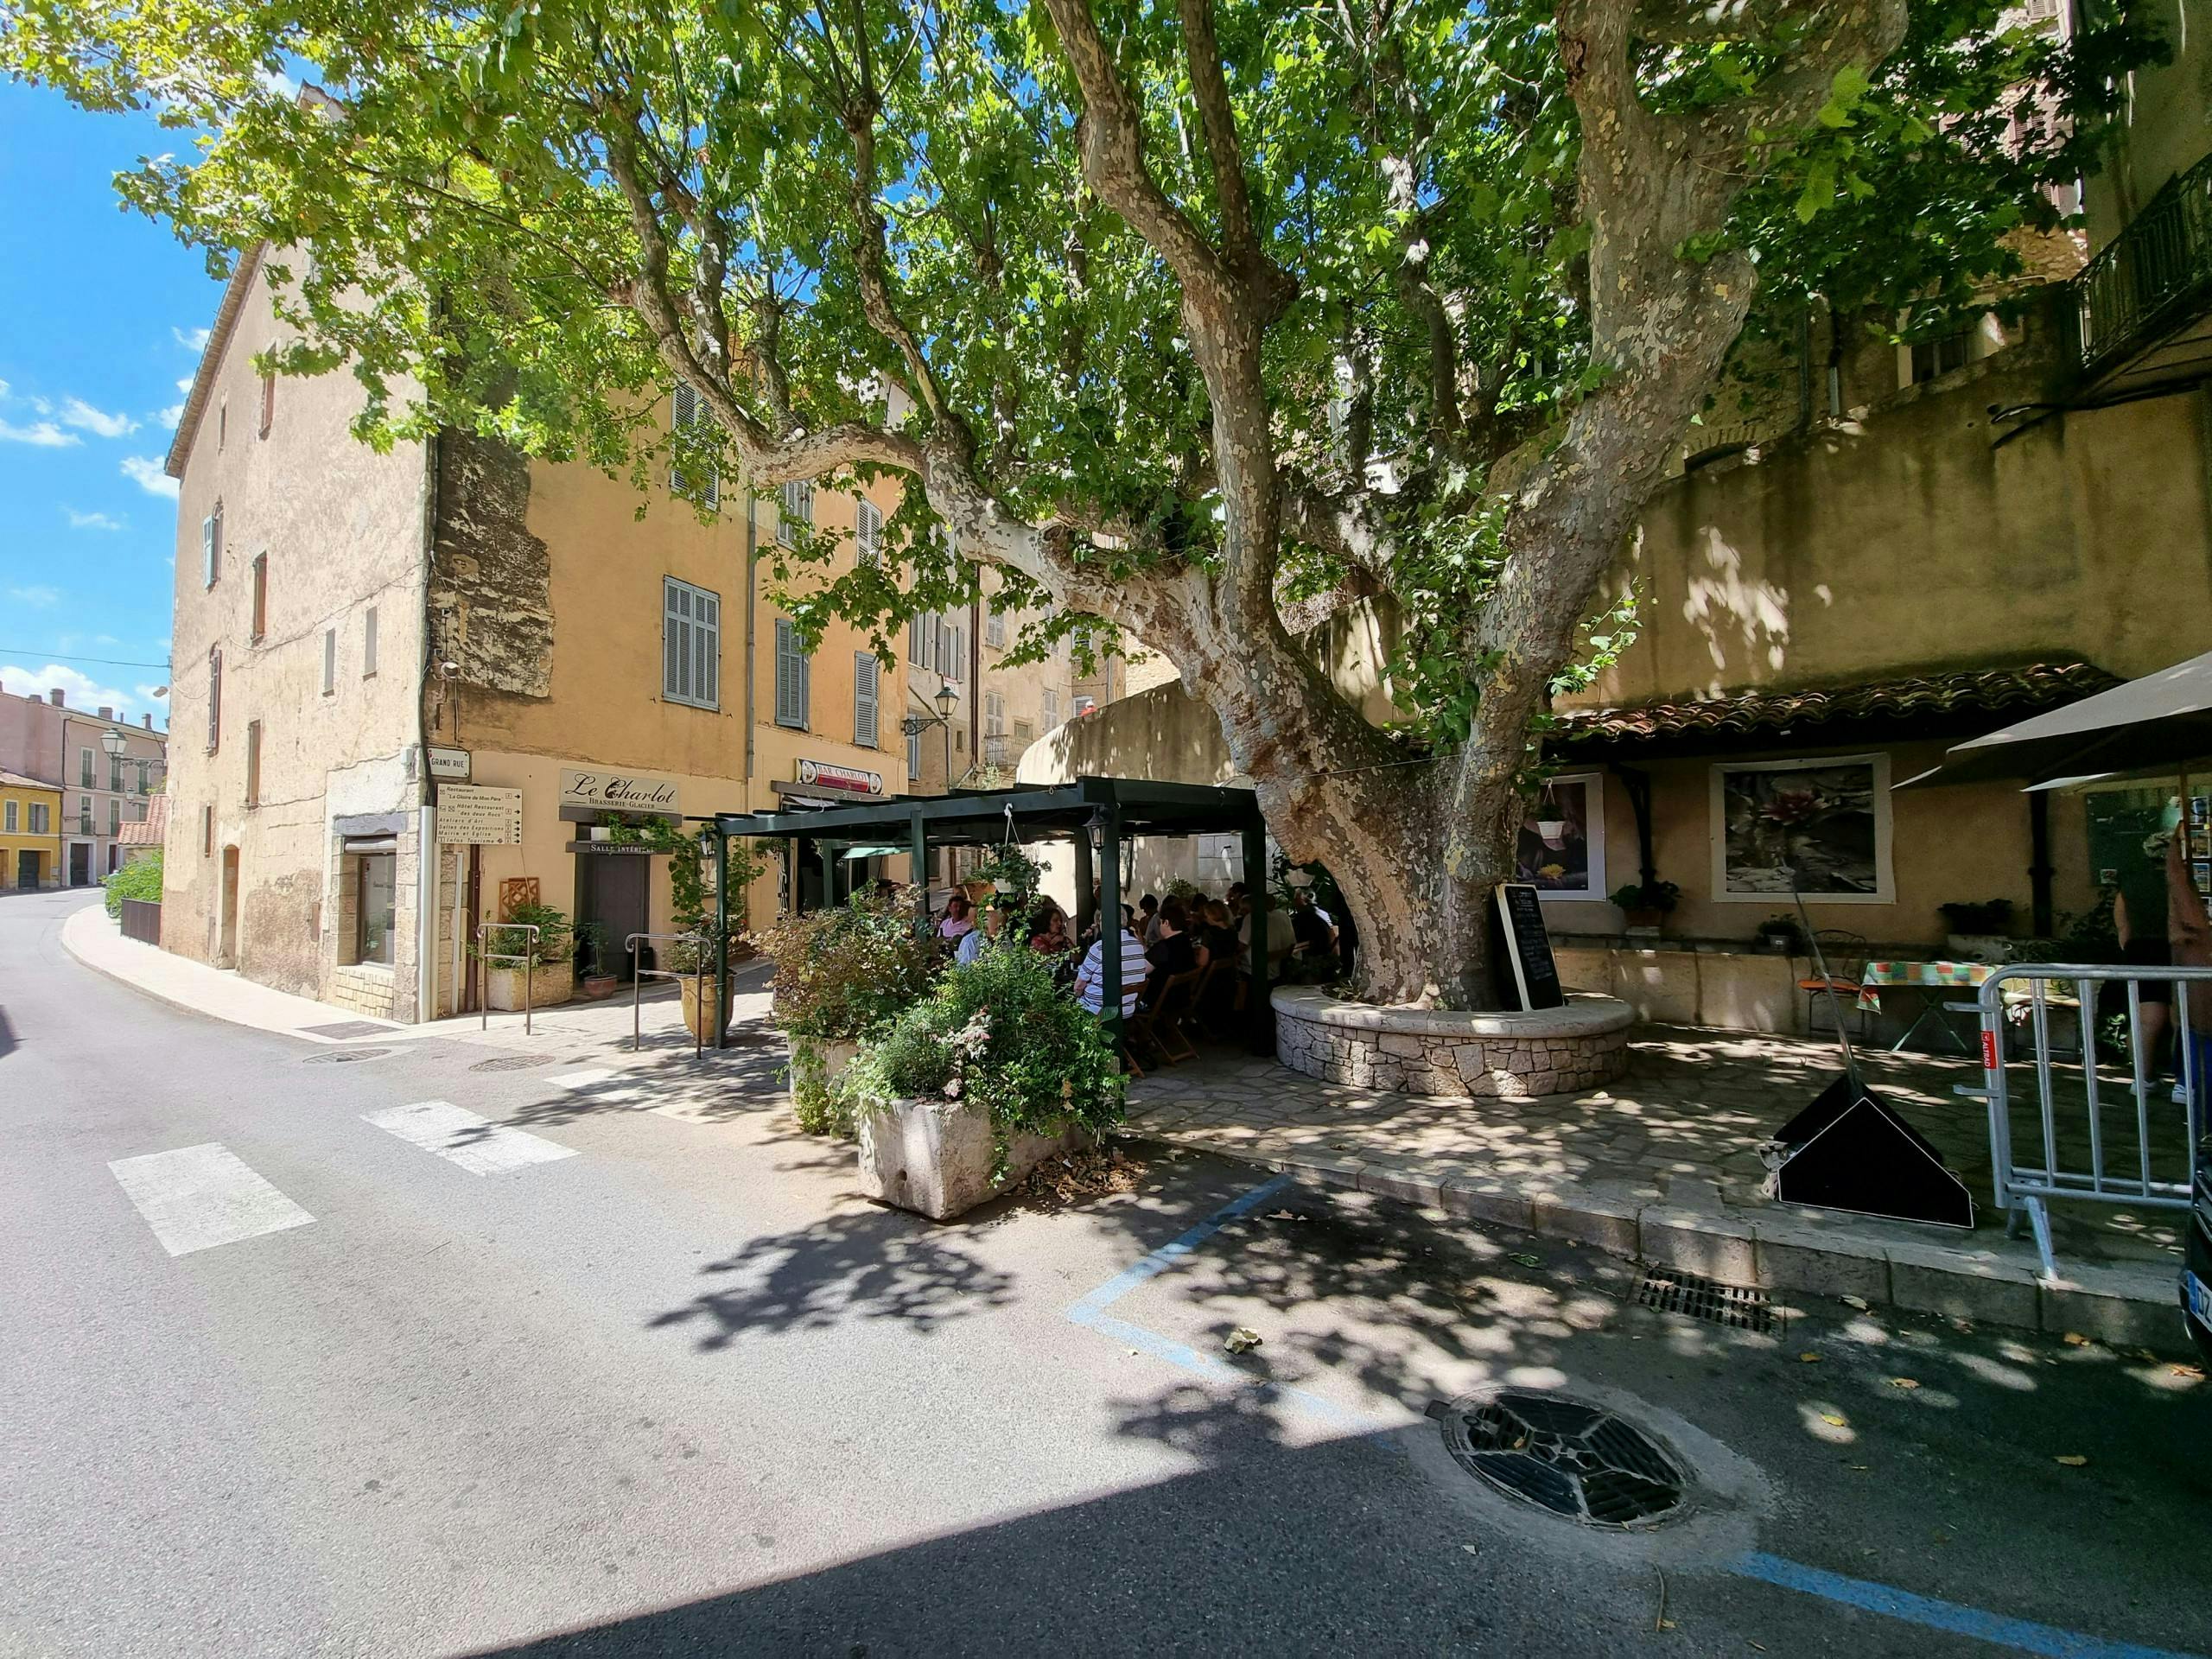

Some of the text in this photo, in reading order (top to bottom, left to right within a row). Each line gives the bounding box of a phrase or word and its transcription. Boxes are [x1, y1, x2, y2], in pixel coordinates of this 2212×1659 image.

[817, 765, 832, 775] BAR
[835, 768, 868, 782] CHARLOT
[564, 772, 676, 804] Le Charlot
[1982, 1041, 1991, 1068] ALTRAD
